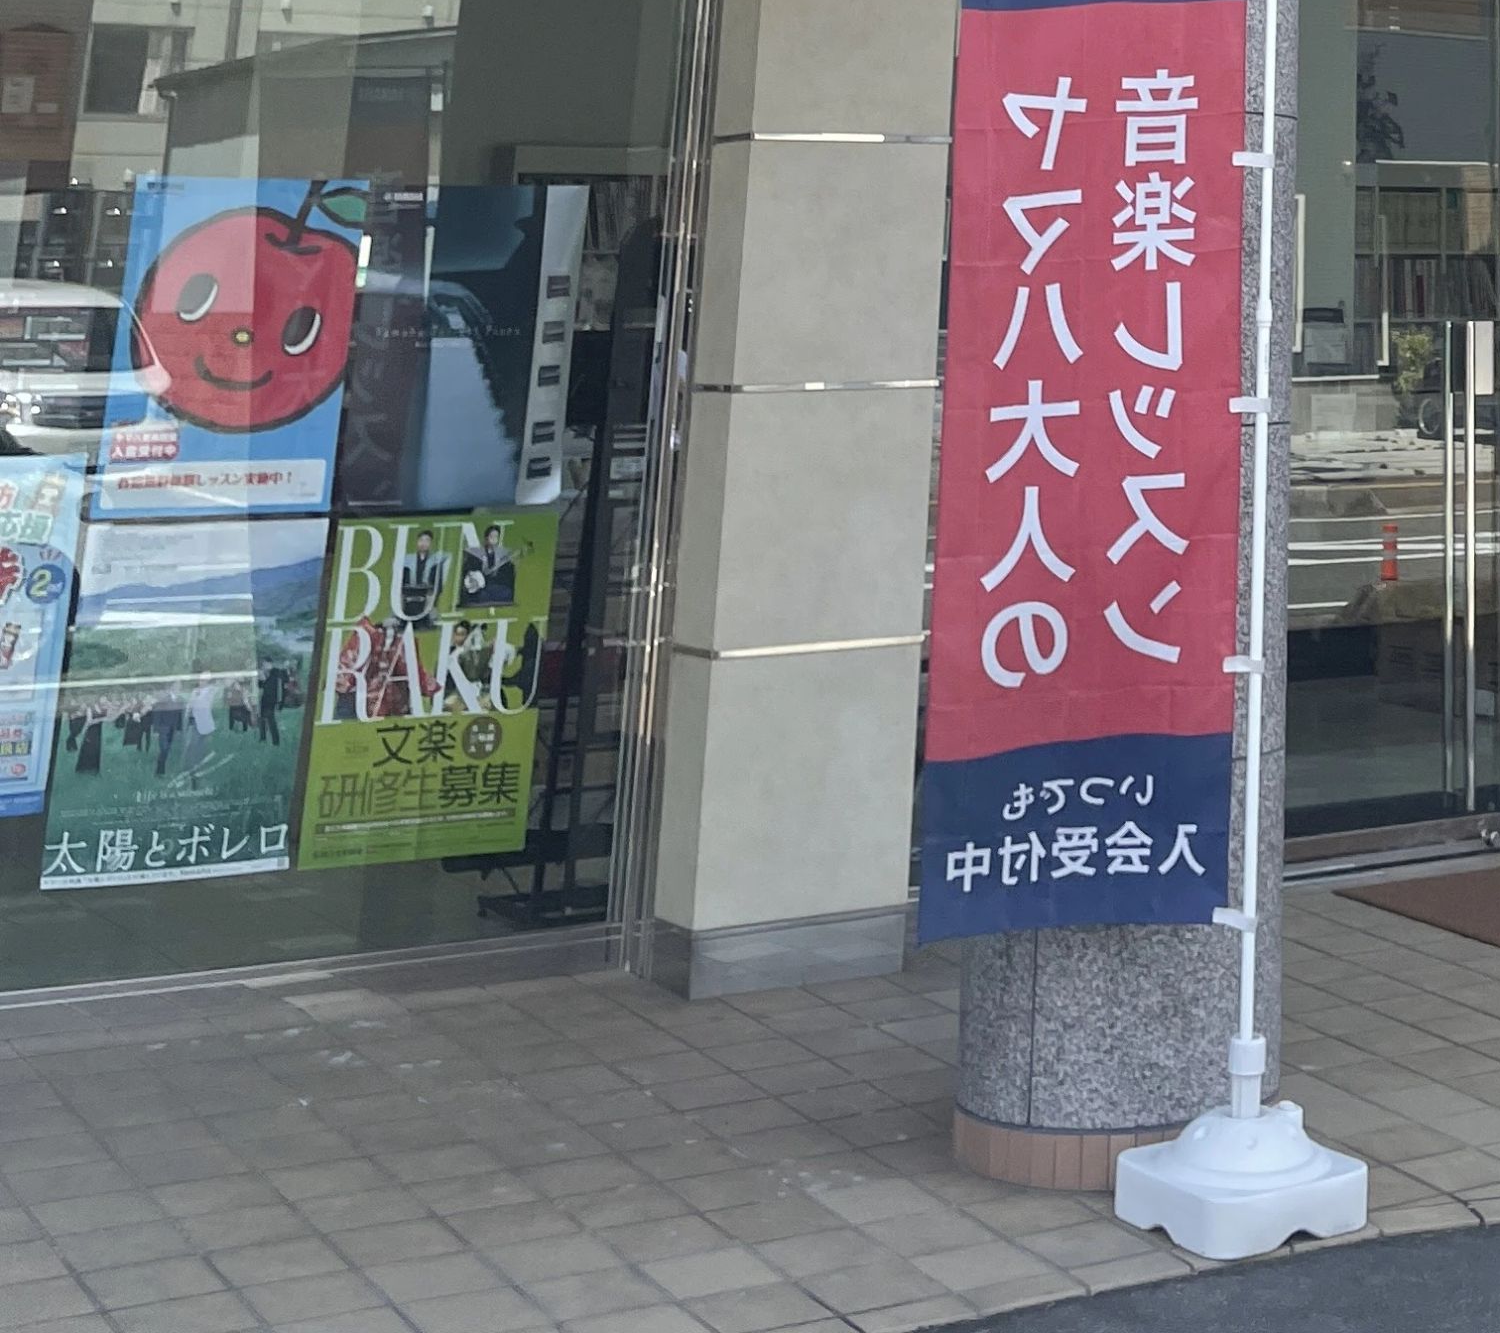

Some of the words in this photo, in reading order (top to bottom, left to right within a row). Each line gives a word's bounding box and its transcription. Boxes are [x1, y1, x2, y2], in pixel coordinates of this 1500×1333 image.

[327, 520, 514, 623] BUN
[314, 613, 548, 725] RAKU
[373, 720, 459, 767] 文楽
[318, 762, 521, 819] 研修生募集
[42, 824, 289, 875] 太陽とボレロ
